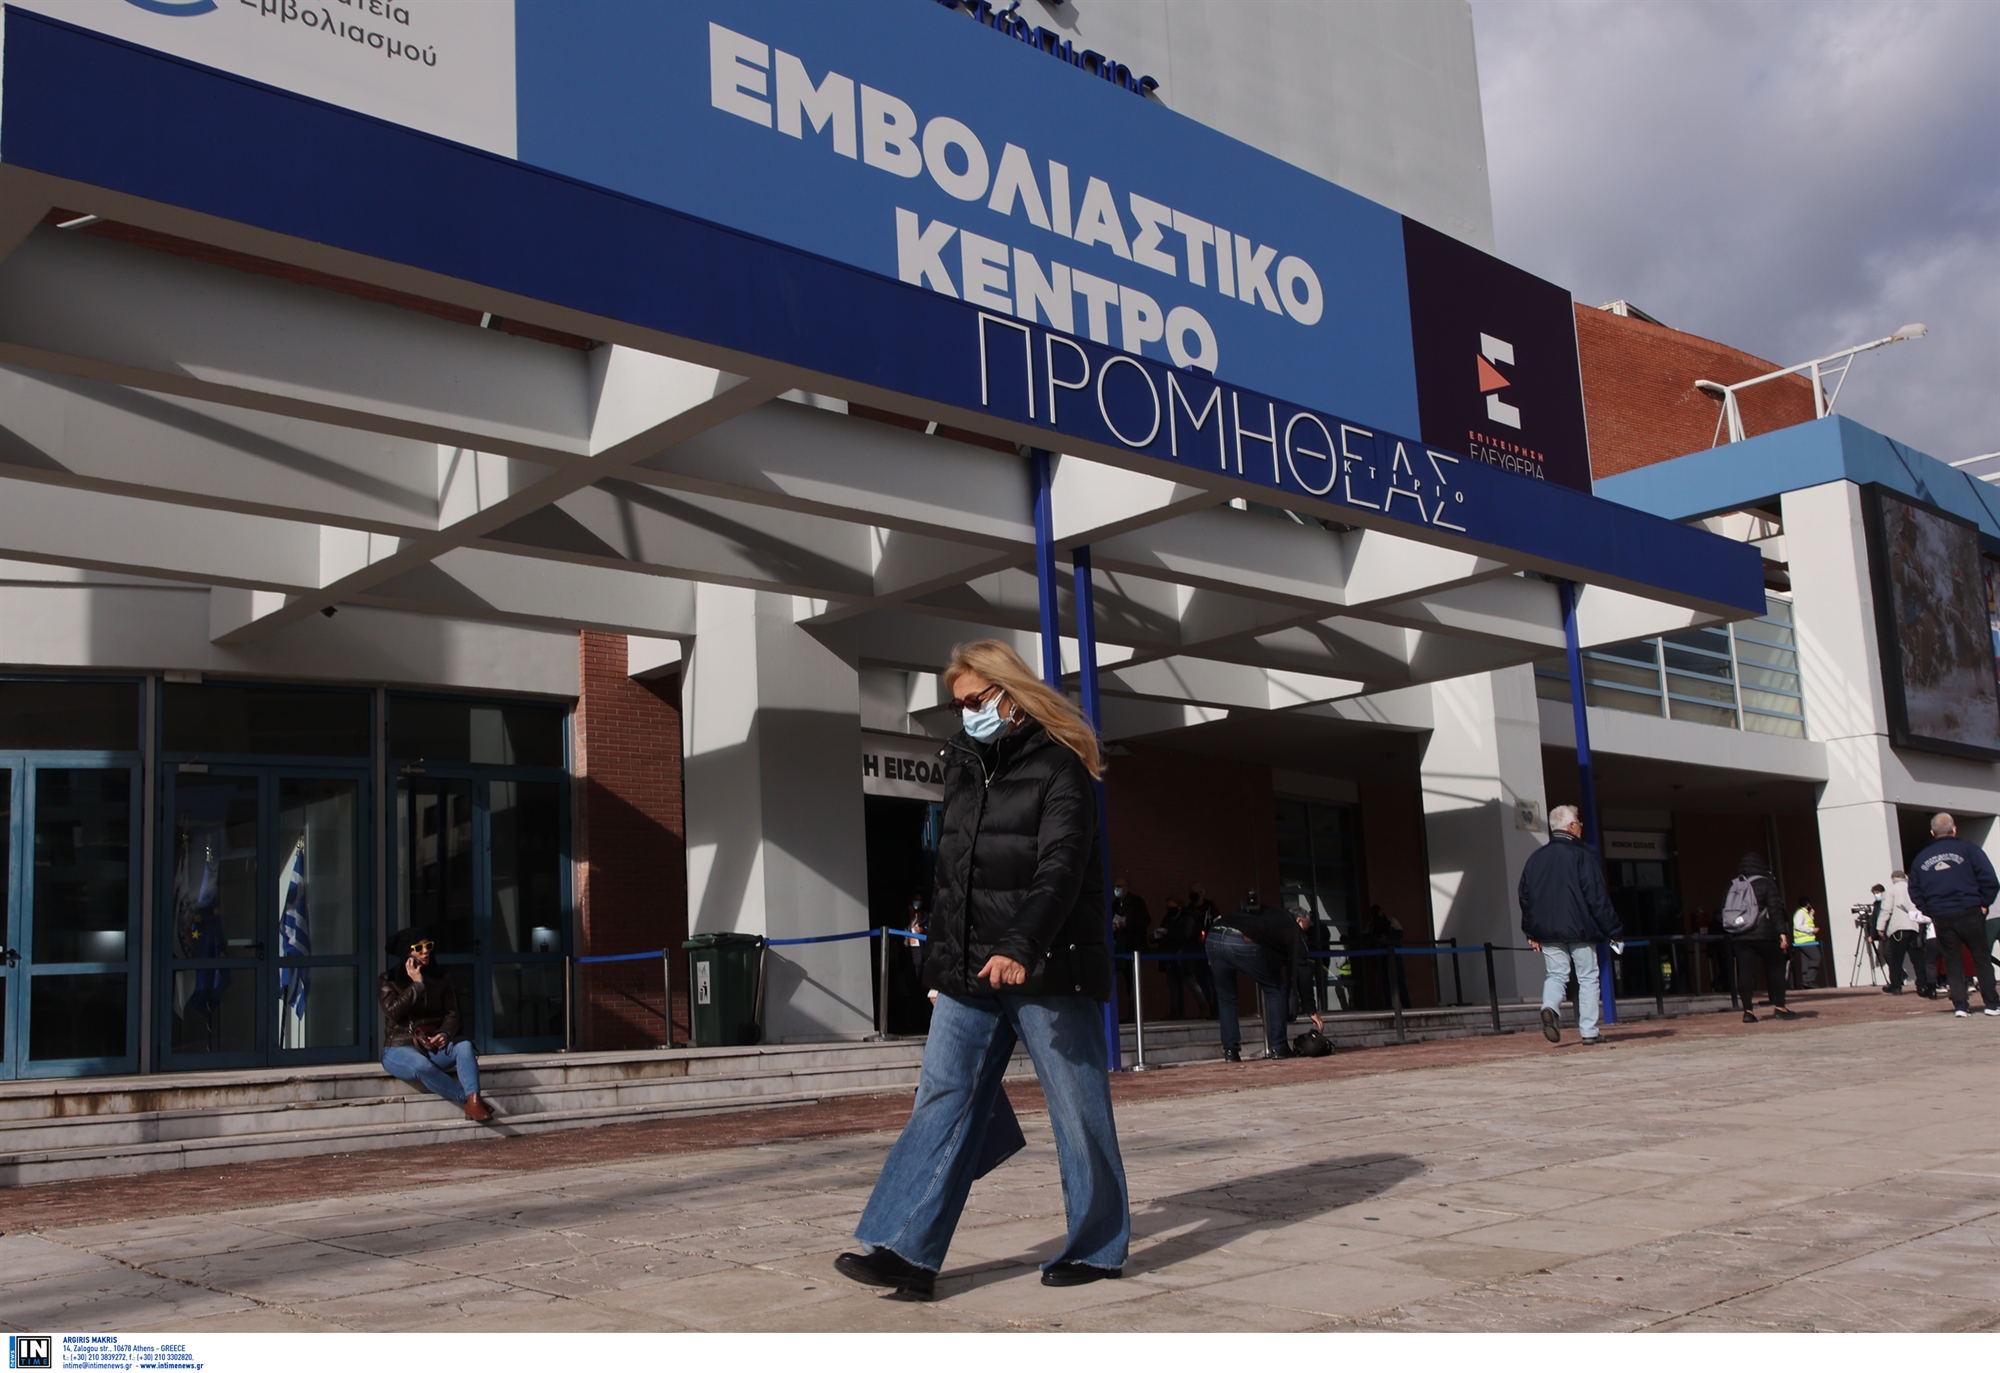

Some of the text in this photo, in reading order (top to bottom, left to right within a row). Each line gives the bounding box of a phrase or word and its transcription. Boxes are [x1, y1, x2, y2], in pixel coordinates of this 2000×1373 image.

[239, 0, 437, 67] μβολιασμού
[709, 21, 1325, 327] ΕΜΒΟΛΙΑΣΤΙΚΟ
[895, 206, 1219, 376] ΚΕΝΤΡΟ
[978, 311, 1467, 533] ΠΡΟΜΗΘΕΑΣ
[1468, 430, 1545, 463] ΕΠΙΧΕΙΡΗΣΗ
[884, 756, 946, 785] ΕΙΣΟΔ
